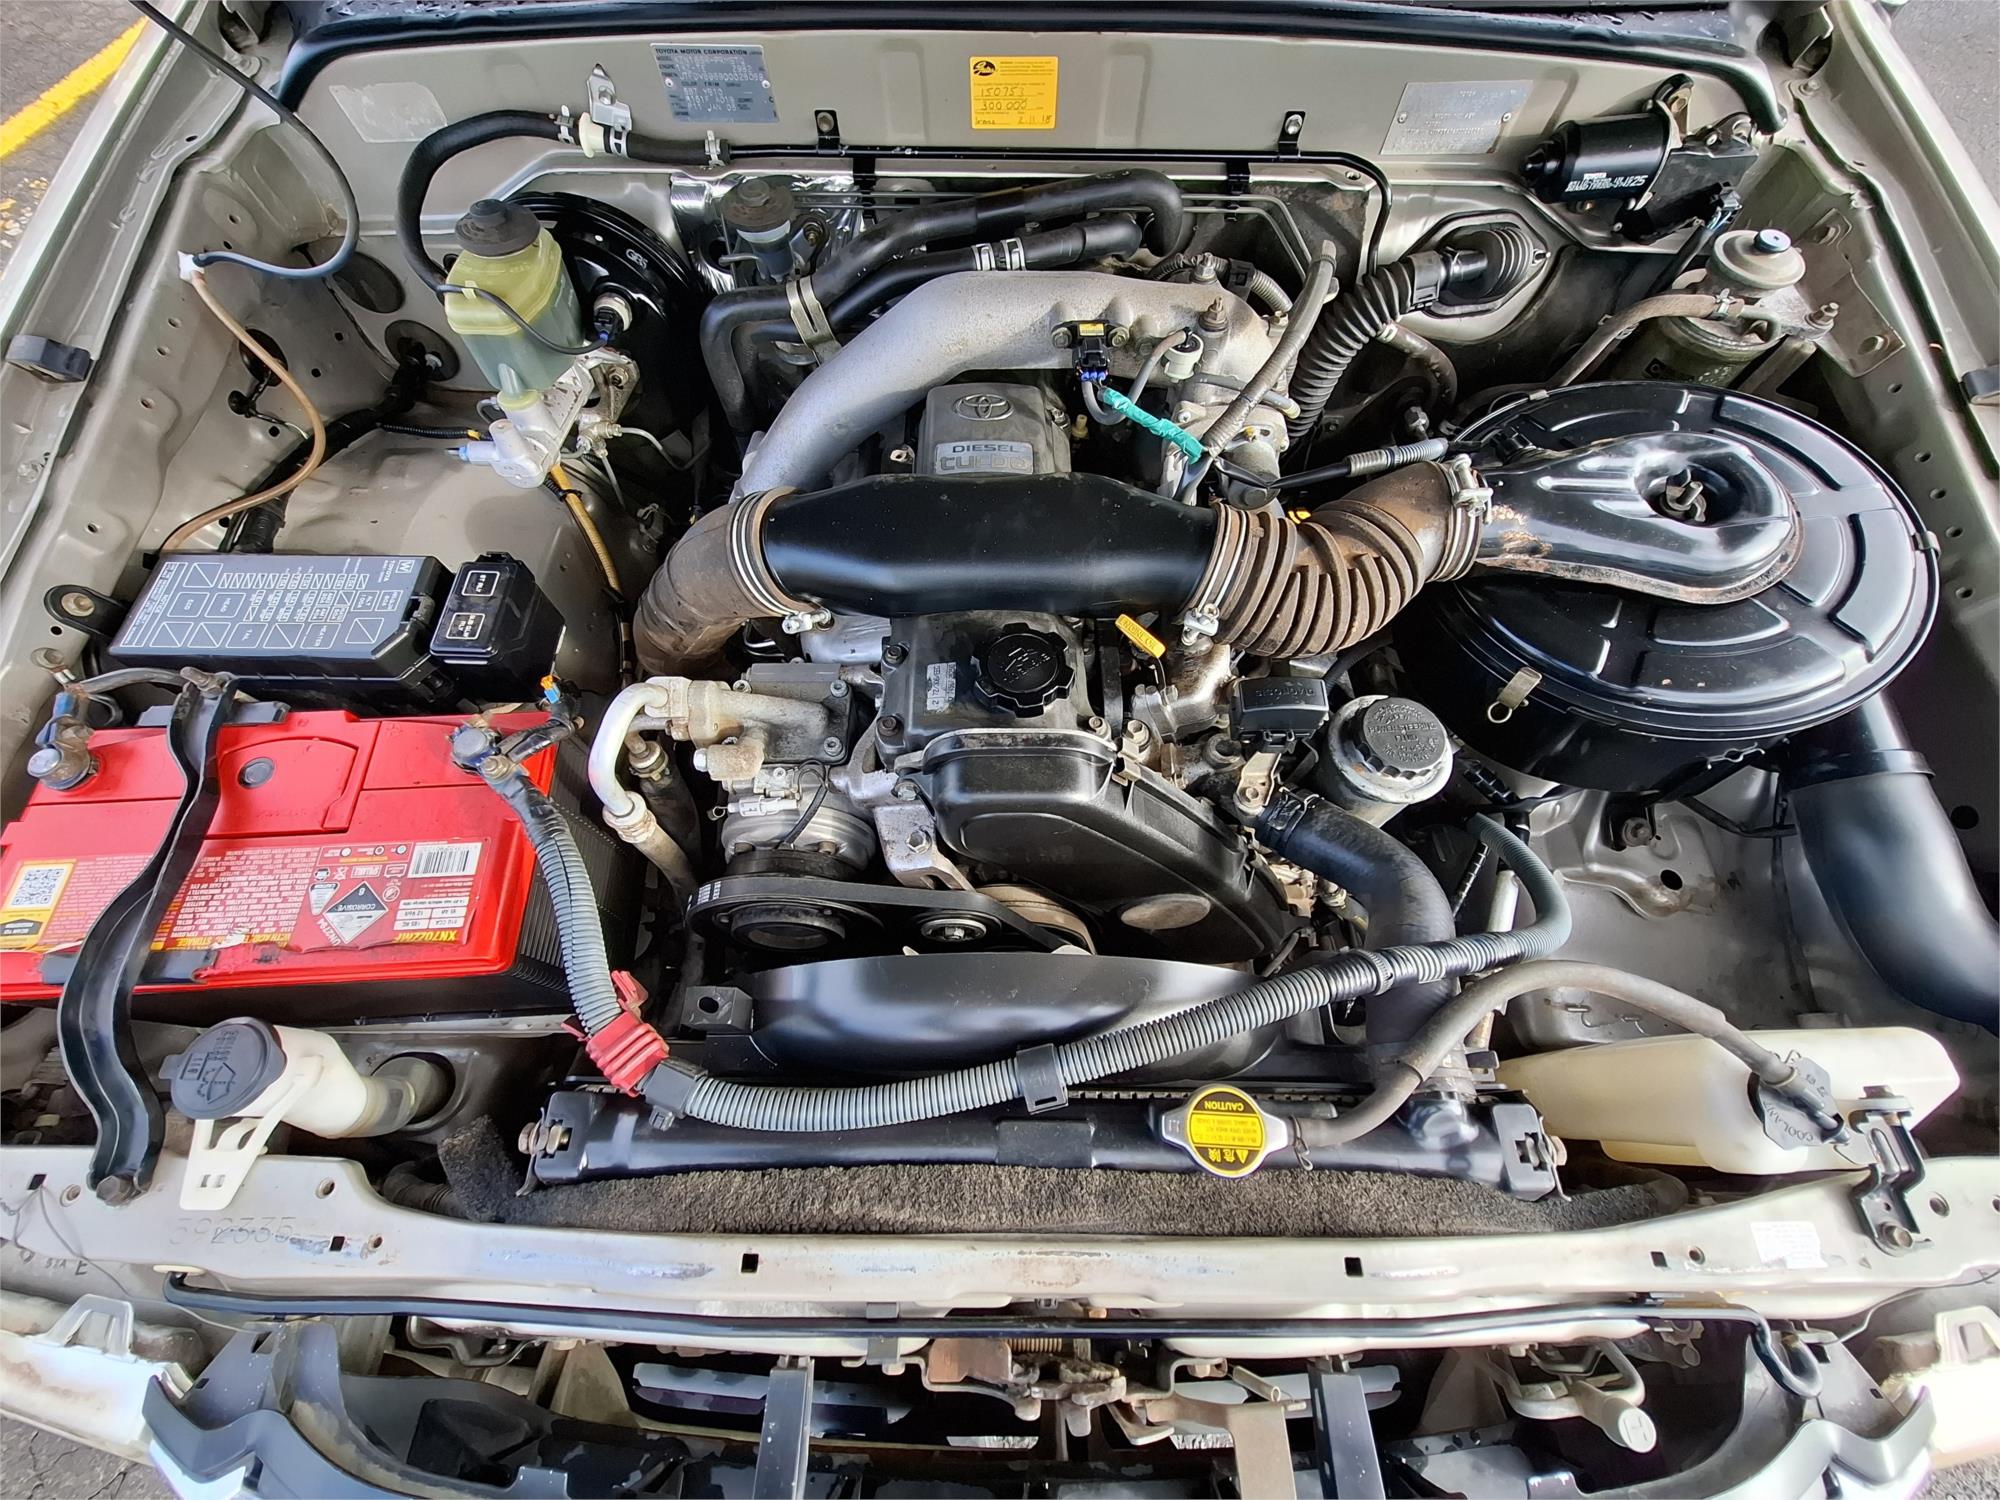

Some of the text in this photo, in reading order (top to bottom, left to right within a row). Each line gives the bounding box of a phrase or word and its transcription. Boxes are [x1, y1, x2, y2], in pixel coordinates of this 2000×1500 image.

[952, 444, 1020, 453] DIESEL
[382, 559, 396, 582] TOYOTA
[398, 560, 411, 571] W
[312, 625, 328, 646] HEATER
[1118, 617, 1144, 642] ENGINE
[338, 903, 376, 912] CORROSIVE
[1204, 1101, 1245, 1112] CAUTION
[1208, 1148, 1235, 1163] 危険
